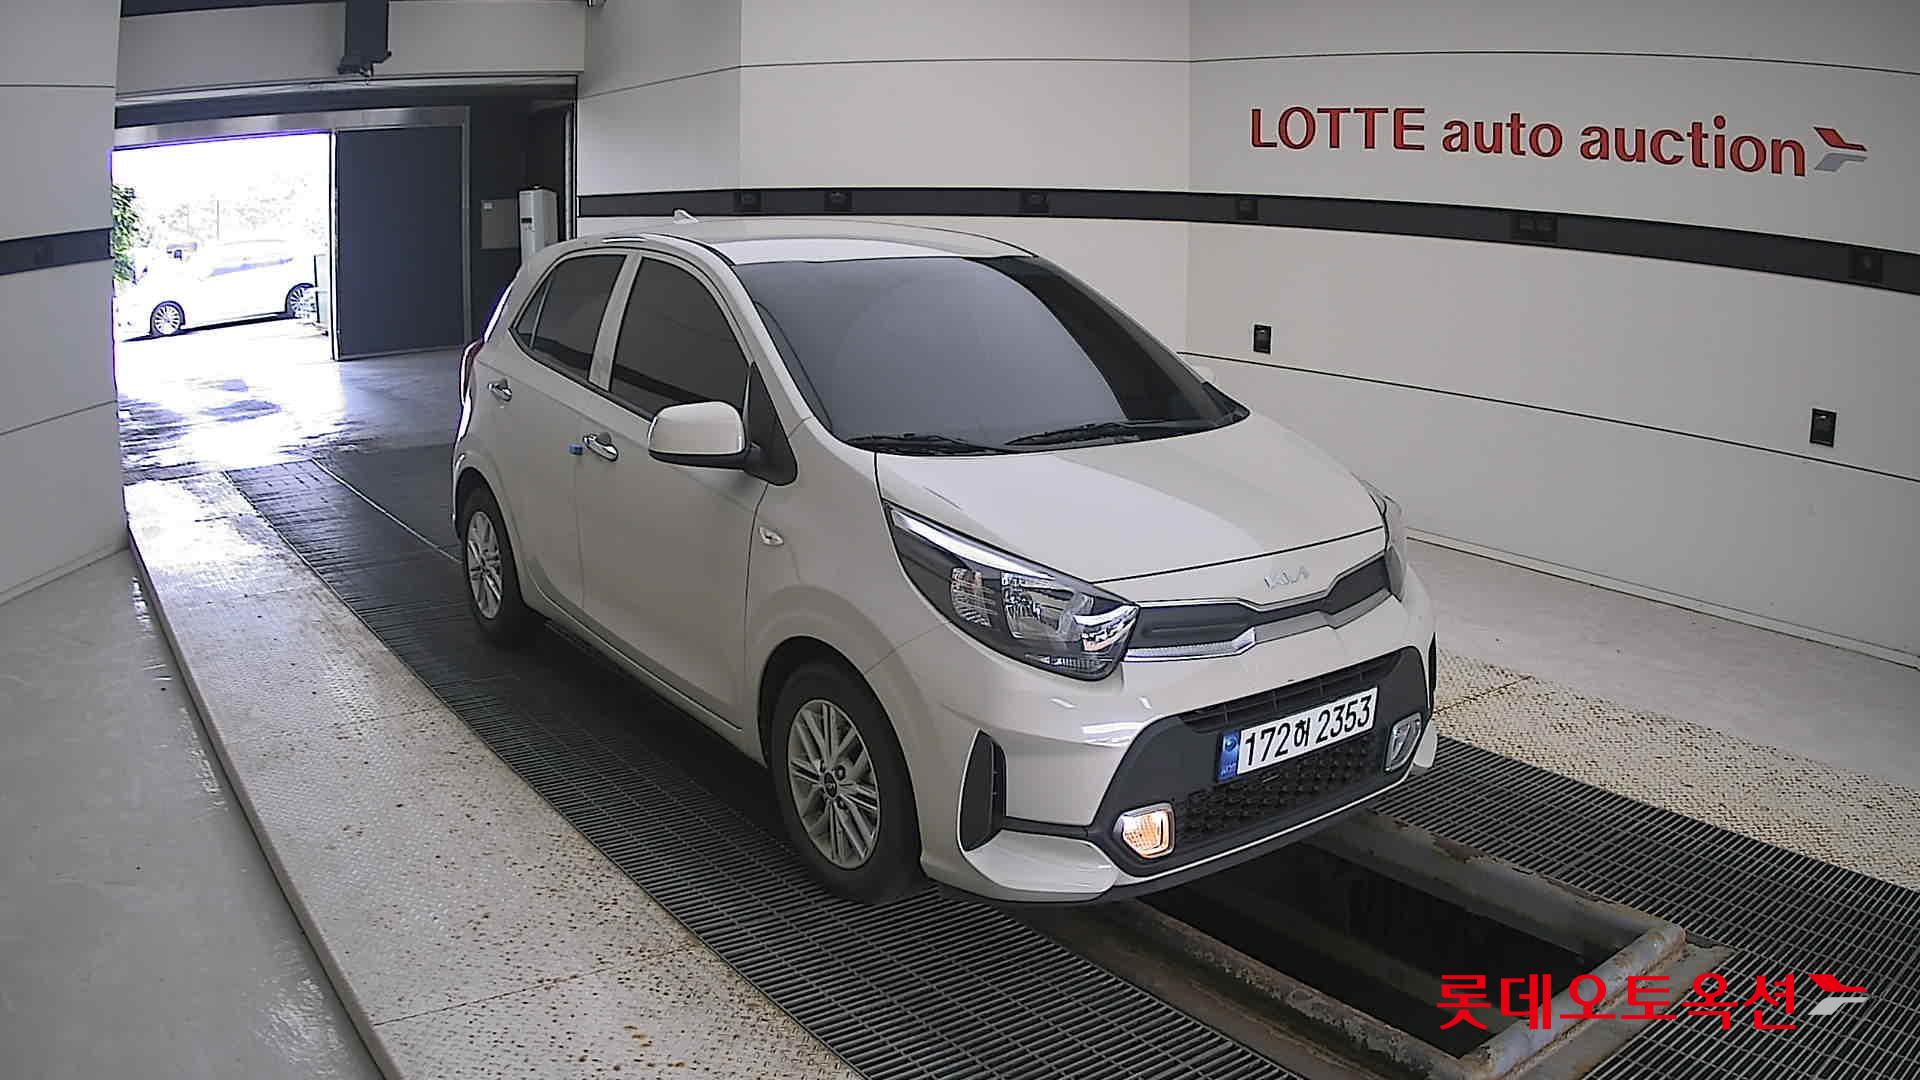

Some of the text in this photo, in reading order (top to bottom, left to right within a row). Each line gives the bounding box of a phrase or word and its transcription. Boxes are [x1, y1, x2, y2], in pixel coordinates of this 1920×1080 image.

[1250, 106, 1806, 177] LOTTE auto auction
[1315, 695, 1372, 744] 2353
